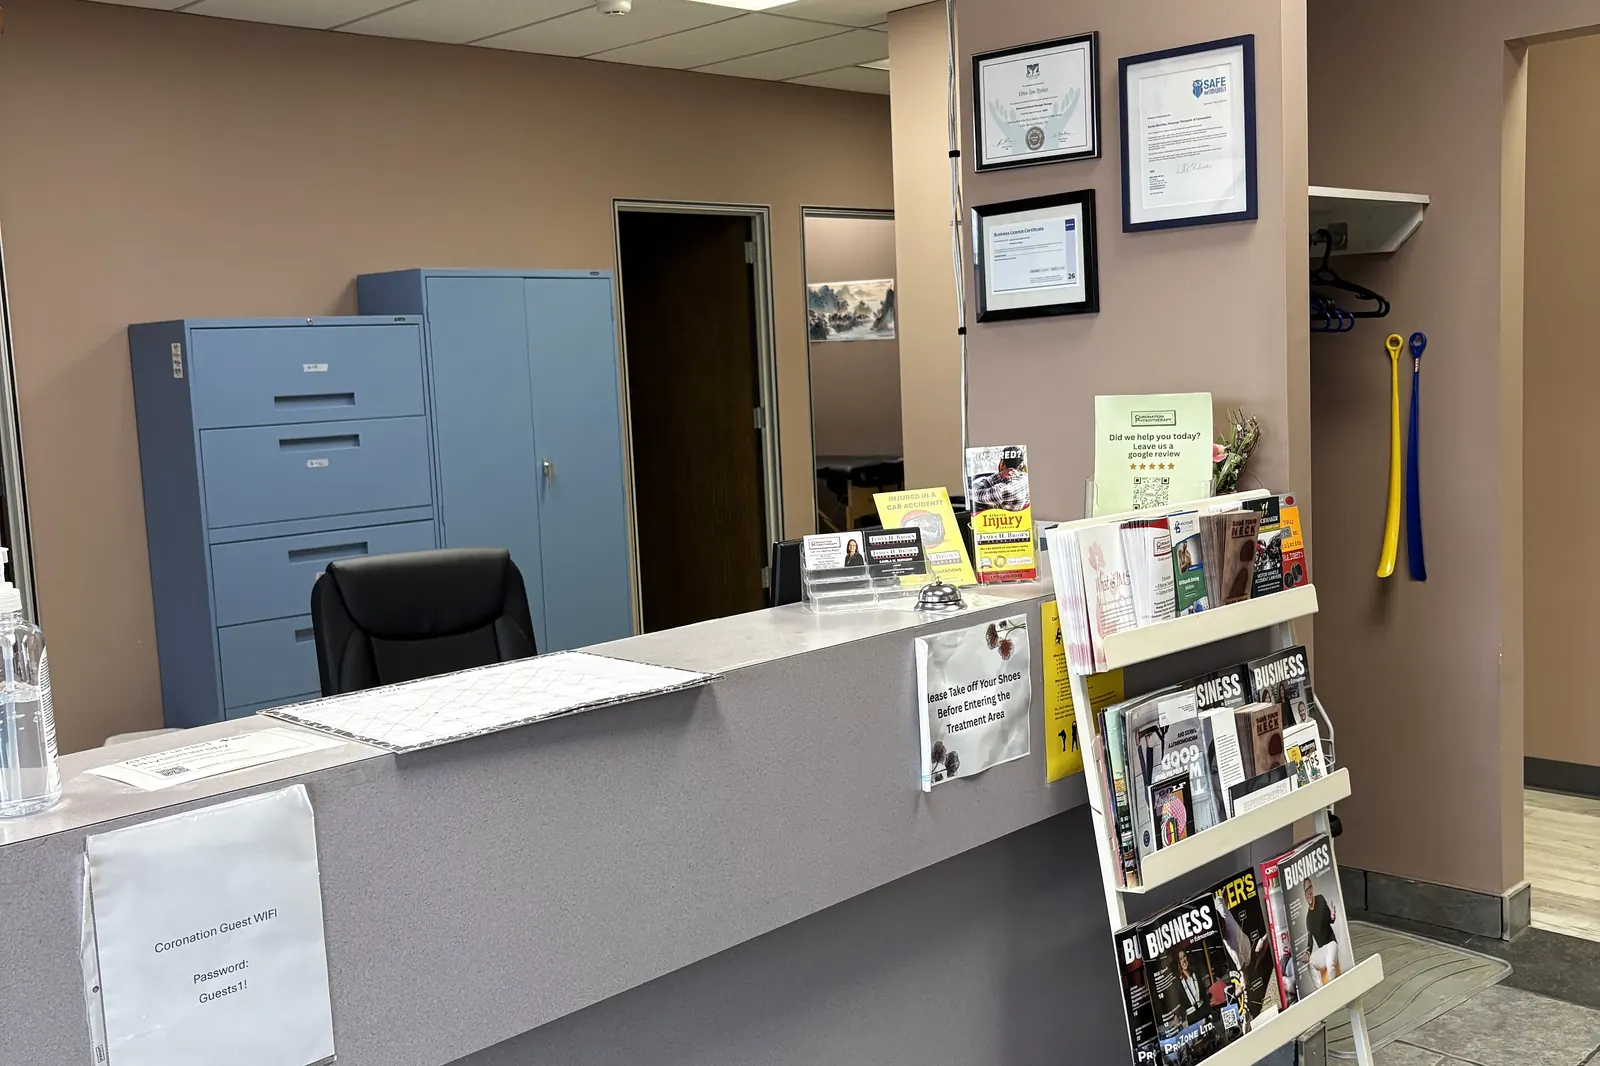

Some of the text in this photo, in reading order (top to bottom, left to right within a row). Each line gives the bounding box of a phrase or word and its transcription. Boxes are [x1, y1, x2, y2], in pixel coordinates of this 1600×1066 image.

[1204, 76, 1226, 90] SAFE
[1137, 433, 1154, 441] help
[1173, 432, 1201, 441] today?
[976, 450, 1022, 460] INJURED?
[1128, 450, 1153, 459] google
[904, 500, 943, 509] ACCIDENT?
[983, 515, 1022, 529] Injury
[1232, 525, 1256, 536] NECK
[1254, 654, 1305, 690] BUSINESS
[928, 672, 1021, 703] lease Take off Your Shoes
[1197, 673, 1241, 707] SINESS
[937, 691, 1010, 718] Before Entering the
[947, 711, 1005, 734] Treatment Area
[1257, 717, 1279, 734] NECK
[1161, 744, 1199, 769] GOOD
[1284, 843, 1330, 891] BUSINESS
[154, 908, 278, 953] Coronation Guest WIFI
[1146, 905, 1213, 959] BUSINESS
[193, 960, 249, 984] Password:
[199, 980, 248, 1004] Guests1!
[1164, 1022, 1215, 1055] PROZONE LTD.
